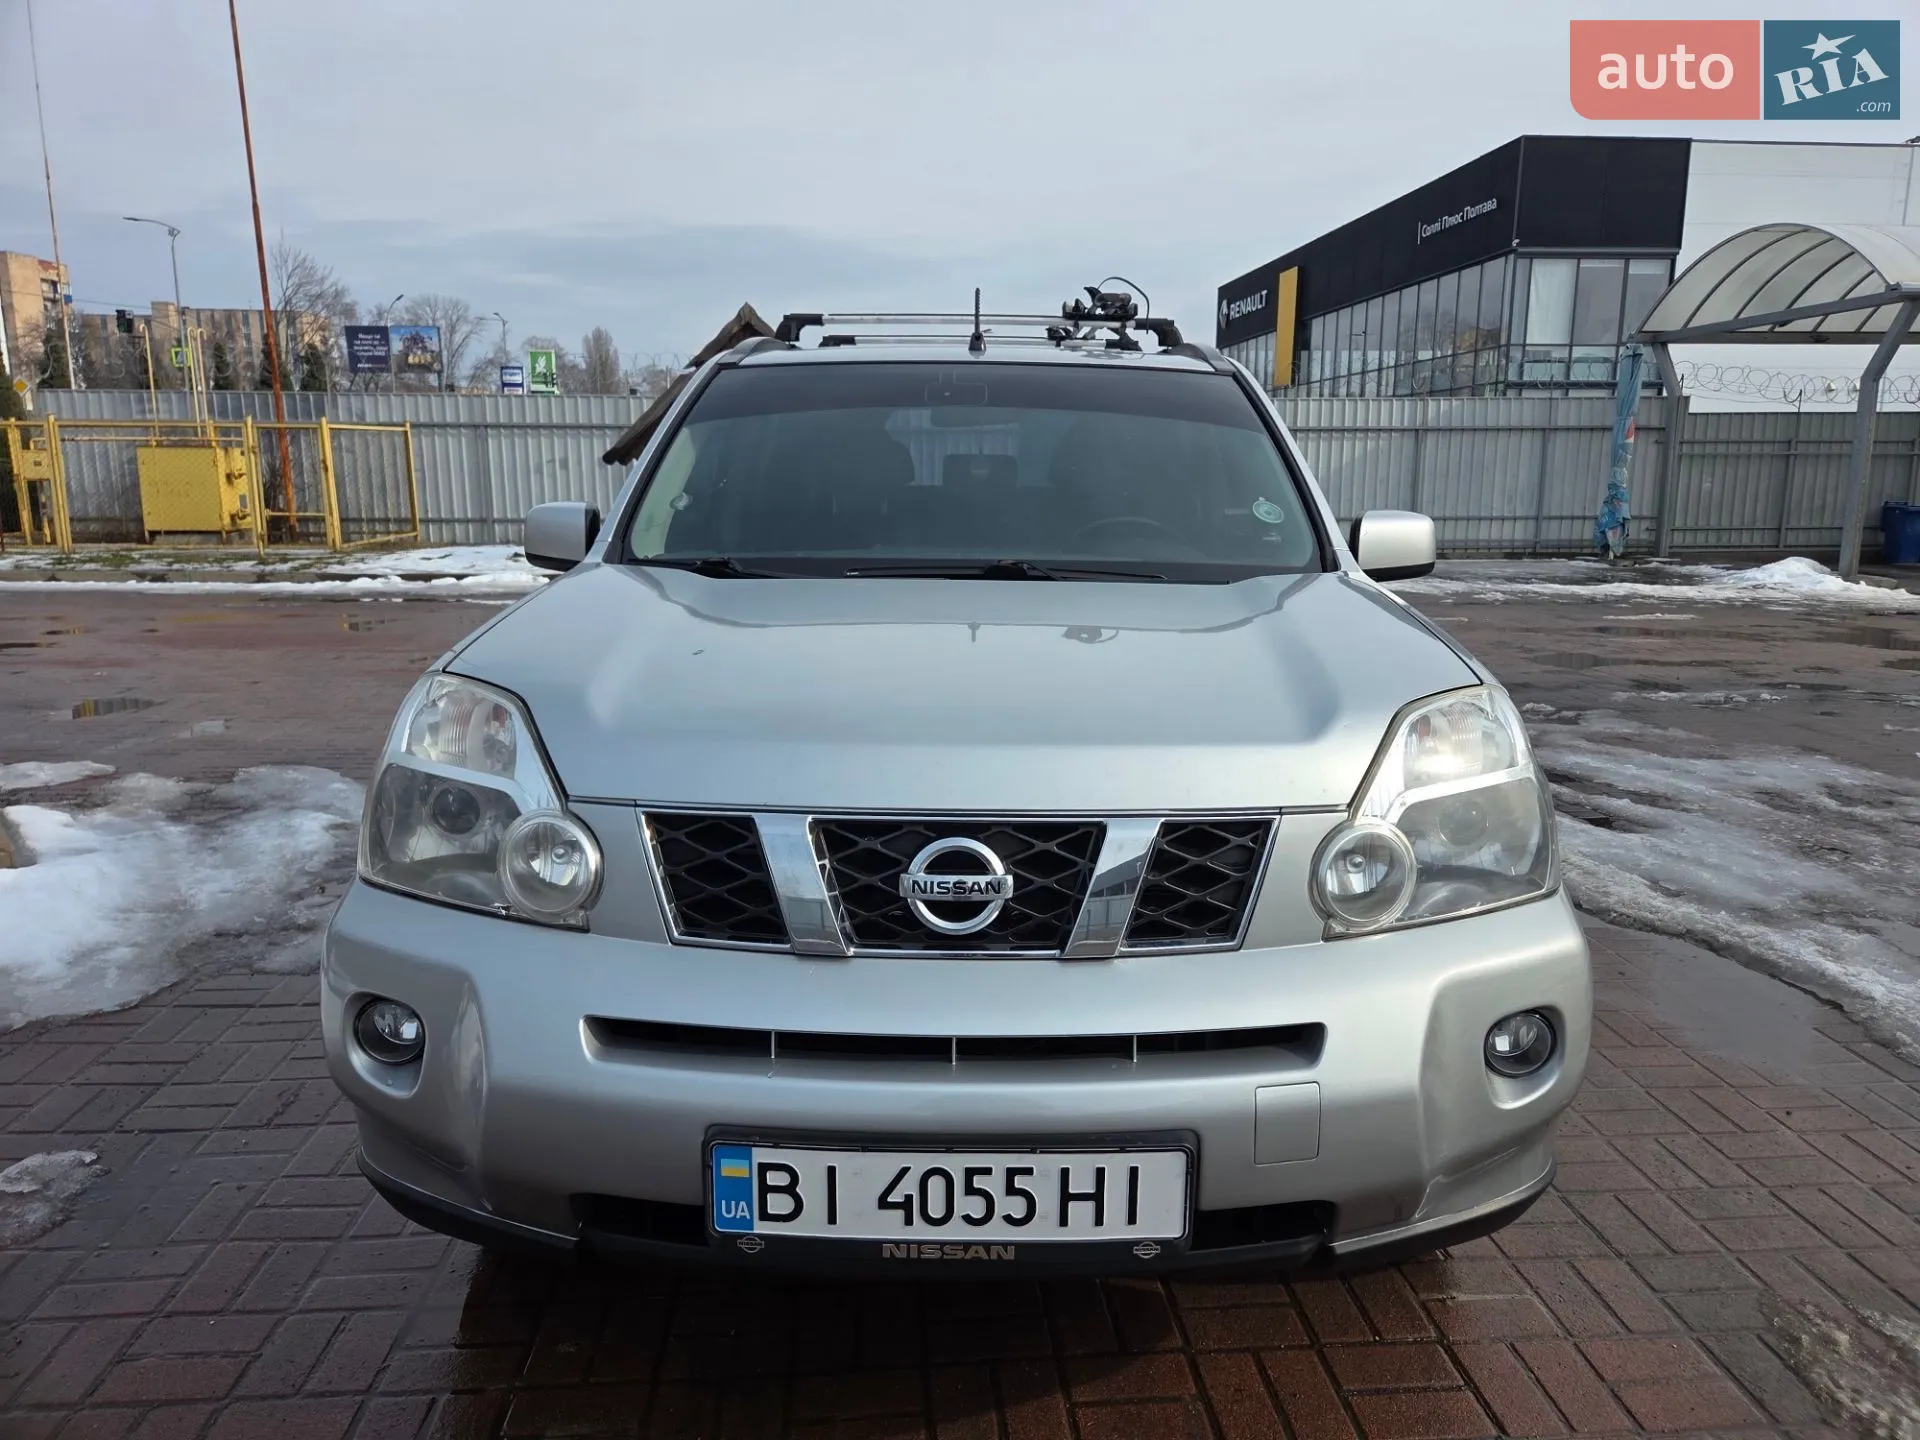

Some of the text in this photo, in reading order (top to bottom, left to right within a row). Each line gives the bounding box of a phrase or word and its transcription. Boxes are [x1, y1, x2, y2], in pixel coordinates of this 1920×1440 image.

[1463, 197, 1497, 221] Полтава
[1229, 289, 1268, 320] RENAULT
[911, 879, 1001, 895] NISSAN
[757, 1162, 1139, 1228] BI 4055 HI
[721, 1199, 751, 1219] UA
[882, 1243, 1015, 1260] NISSAN
